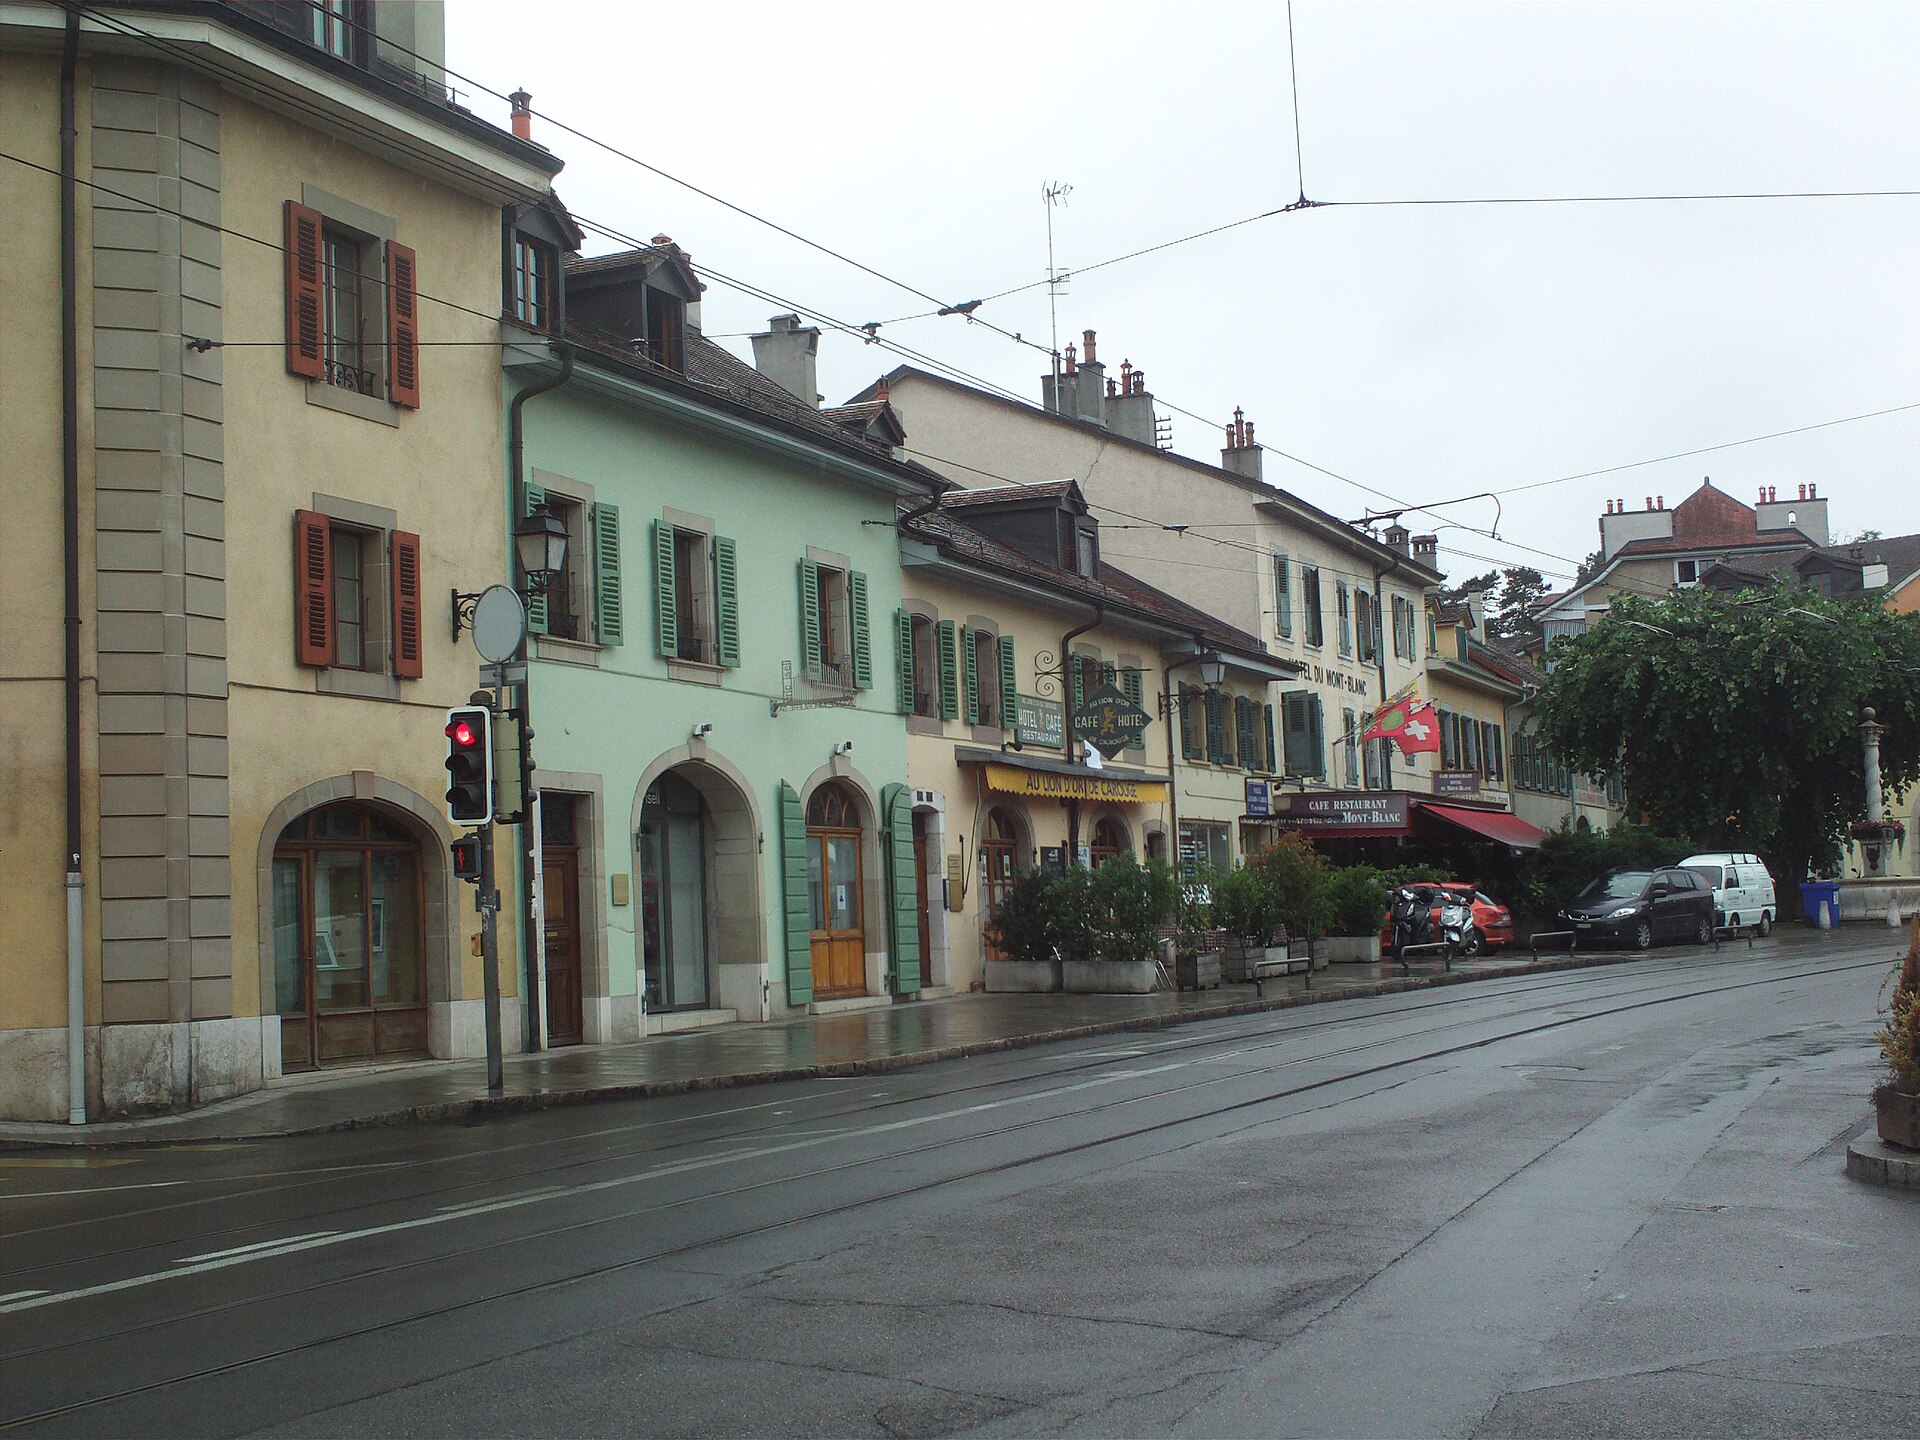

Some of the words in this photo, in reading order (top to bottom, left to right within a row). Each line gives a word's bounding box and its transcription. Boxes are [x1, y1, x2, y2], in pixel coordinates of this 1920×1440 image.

[1314, 665, 1324, 684] DU
[1018, 708, 1038, 728] HOTEL
[1074, 714, 1099, 728] CAFÉ
[1117, 713, 1145, 727] HOTEL
[1022, 729, 1061, 744] RESTAURANT
[1026, 773, 1040, 791] AU
[1042, 775, 1062, 793] LION
[1064, 777, 1085, 794] D'OR
[1088, 780, 1099, 795] DE
[1101, 780, 1137, 798] CAROUGE
[1309, 800, 1330, 811] CAFE
[1333, 799, 1387, 810] RESTAURANT
